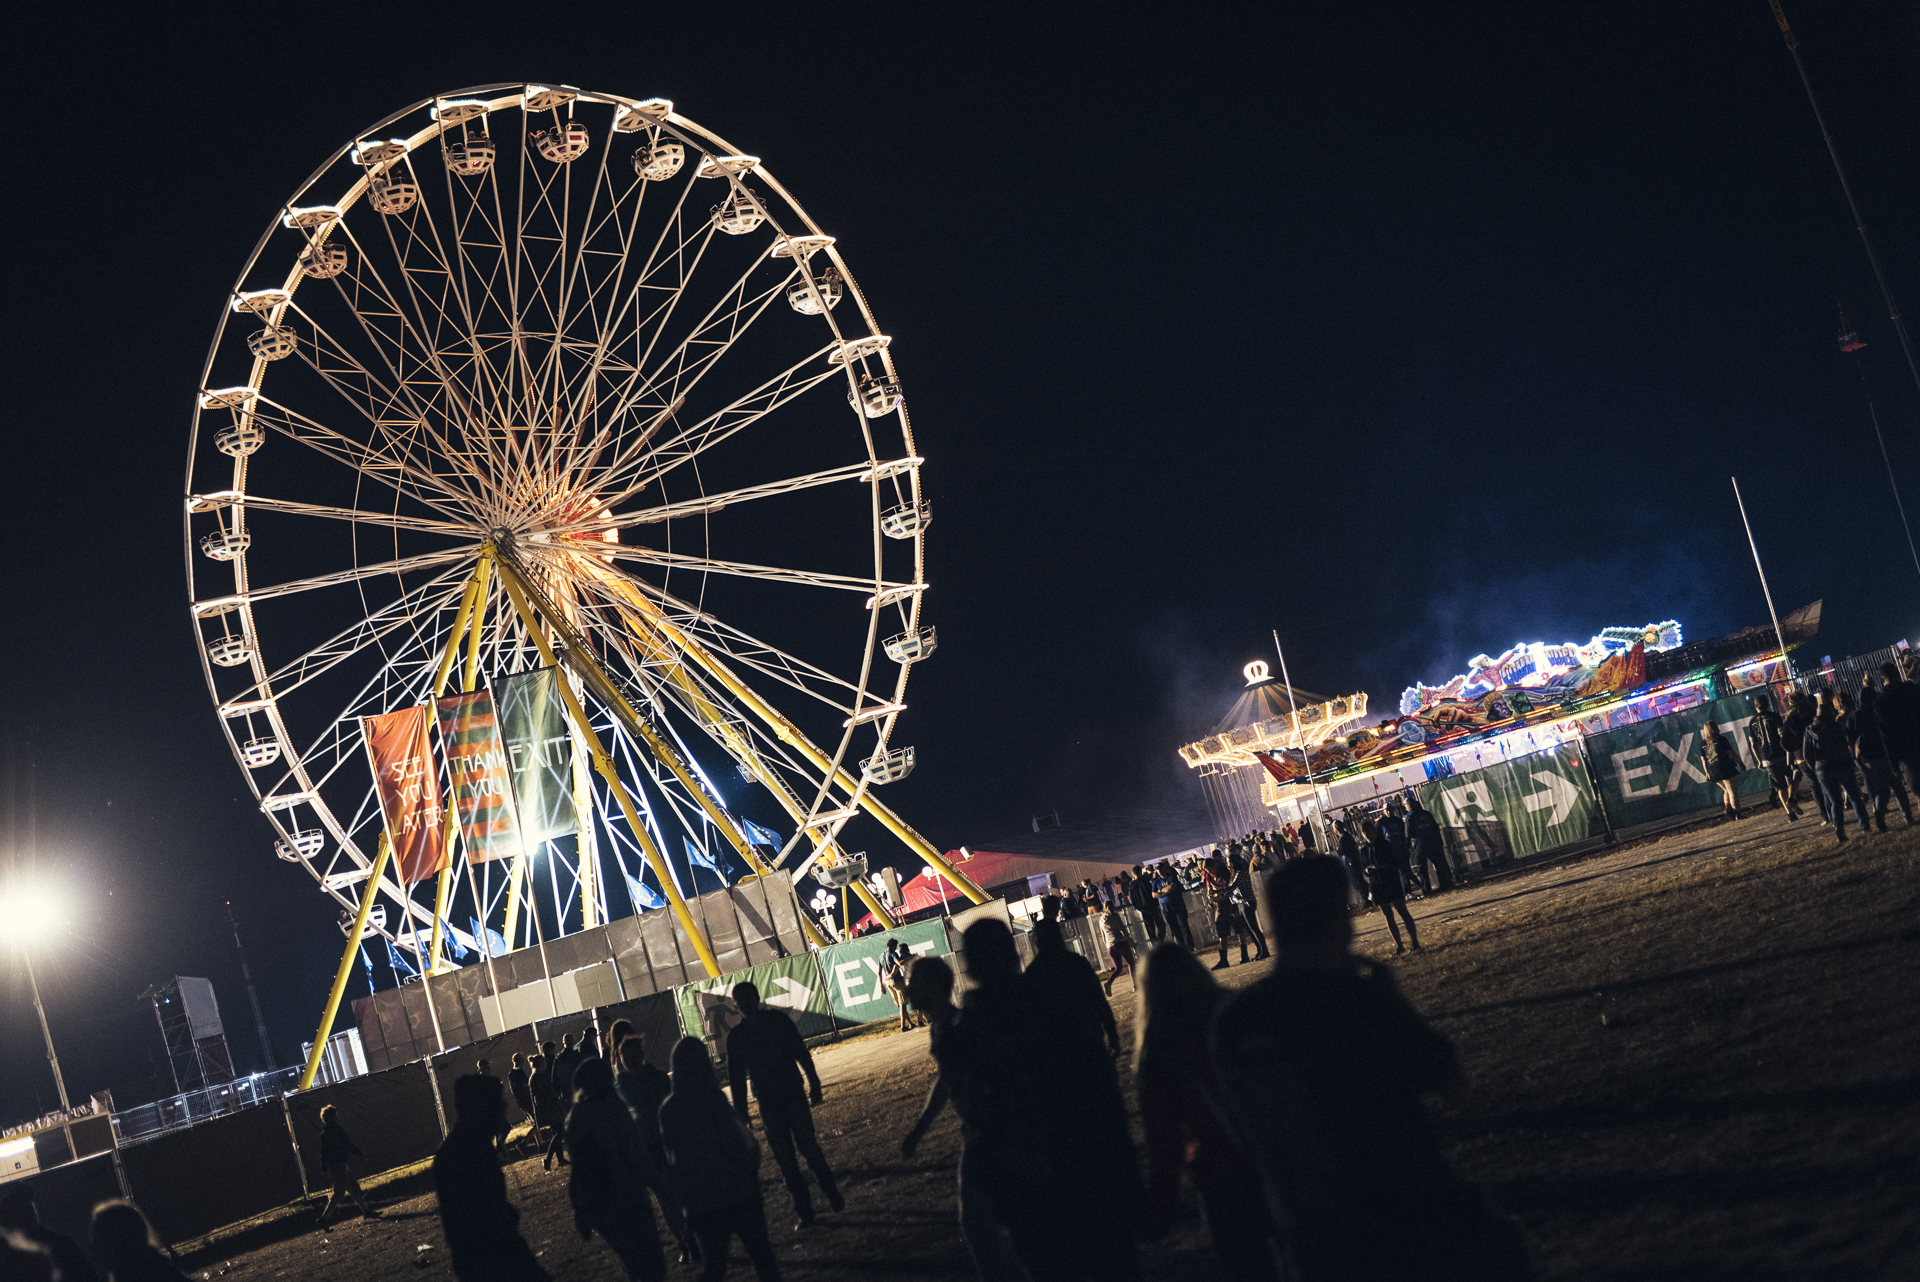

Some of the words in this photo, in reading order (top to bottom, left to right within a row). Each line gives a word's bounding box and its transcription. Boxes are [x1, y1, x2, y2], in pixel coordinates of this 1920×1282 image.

[508, 736, 564, 773] EXIT
[1611, 715, 1755, 803] EXT
[391, 755, 425, 782] SEE
[395, 780, 432, 807] YOU
[467, 776, 503, 799] YOU
